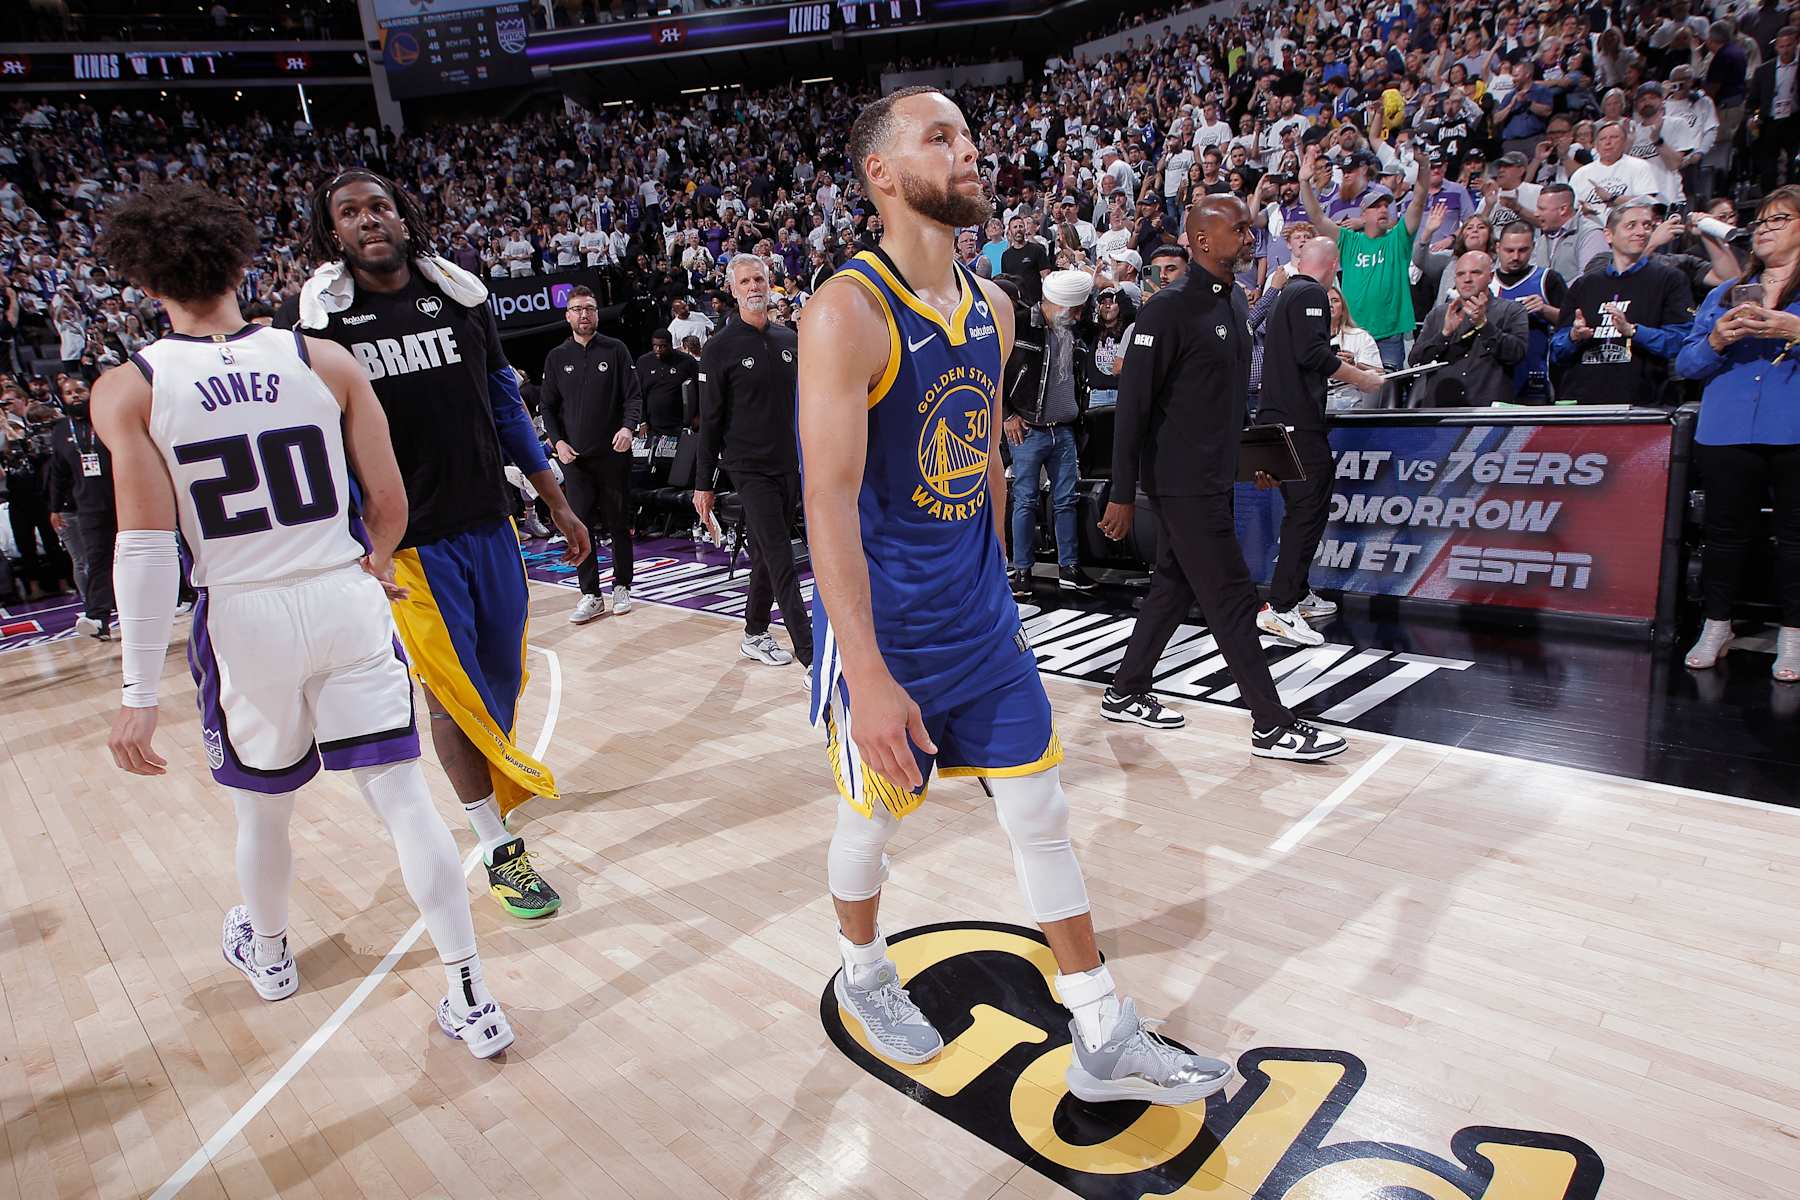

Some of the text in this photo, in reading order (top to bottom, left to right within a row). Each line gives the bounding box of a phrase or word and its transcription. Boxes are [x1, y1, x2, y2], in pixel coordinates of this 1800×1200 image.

[496, 5, 519, 14] KINGS
[788, 4, 830, 34] KINGS
[73, 54, 120, 79] KINGS
[1438, 123, 1468, 142] KINGS
[1446, 140, 1458, 156] 4
[342, 312, 377, 325] Rakuten
[487, 286, 550, 321] lpad
[969, 324, 996, 338] Rakuten
[1134, 333, 1155, 348] DEKI
[195, 372, 280, 412] JONES
[918, 366, 996, 414] GOLDEN STATE
[964, 408, 988, 443] 30
[173, 424, 339, 540] 20
[1331, 450, 1392, 481] AT
[1442, 451, 1608, 486] 76ERS
[911, 484, 985, 521] WARRIO
[1328, 493, 1564, 533] OMORROW
[1358, 540, 1423, 573] ET
[1447, 545, 1593, 590] ESPN
[1018, 603, 1476, 724] NAMENT
[505, 753, 542, 778] WARRIORS
[506, 843, 517, 856] W
